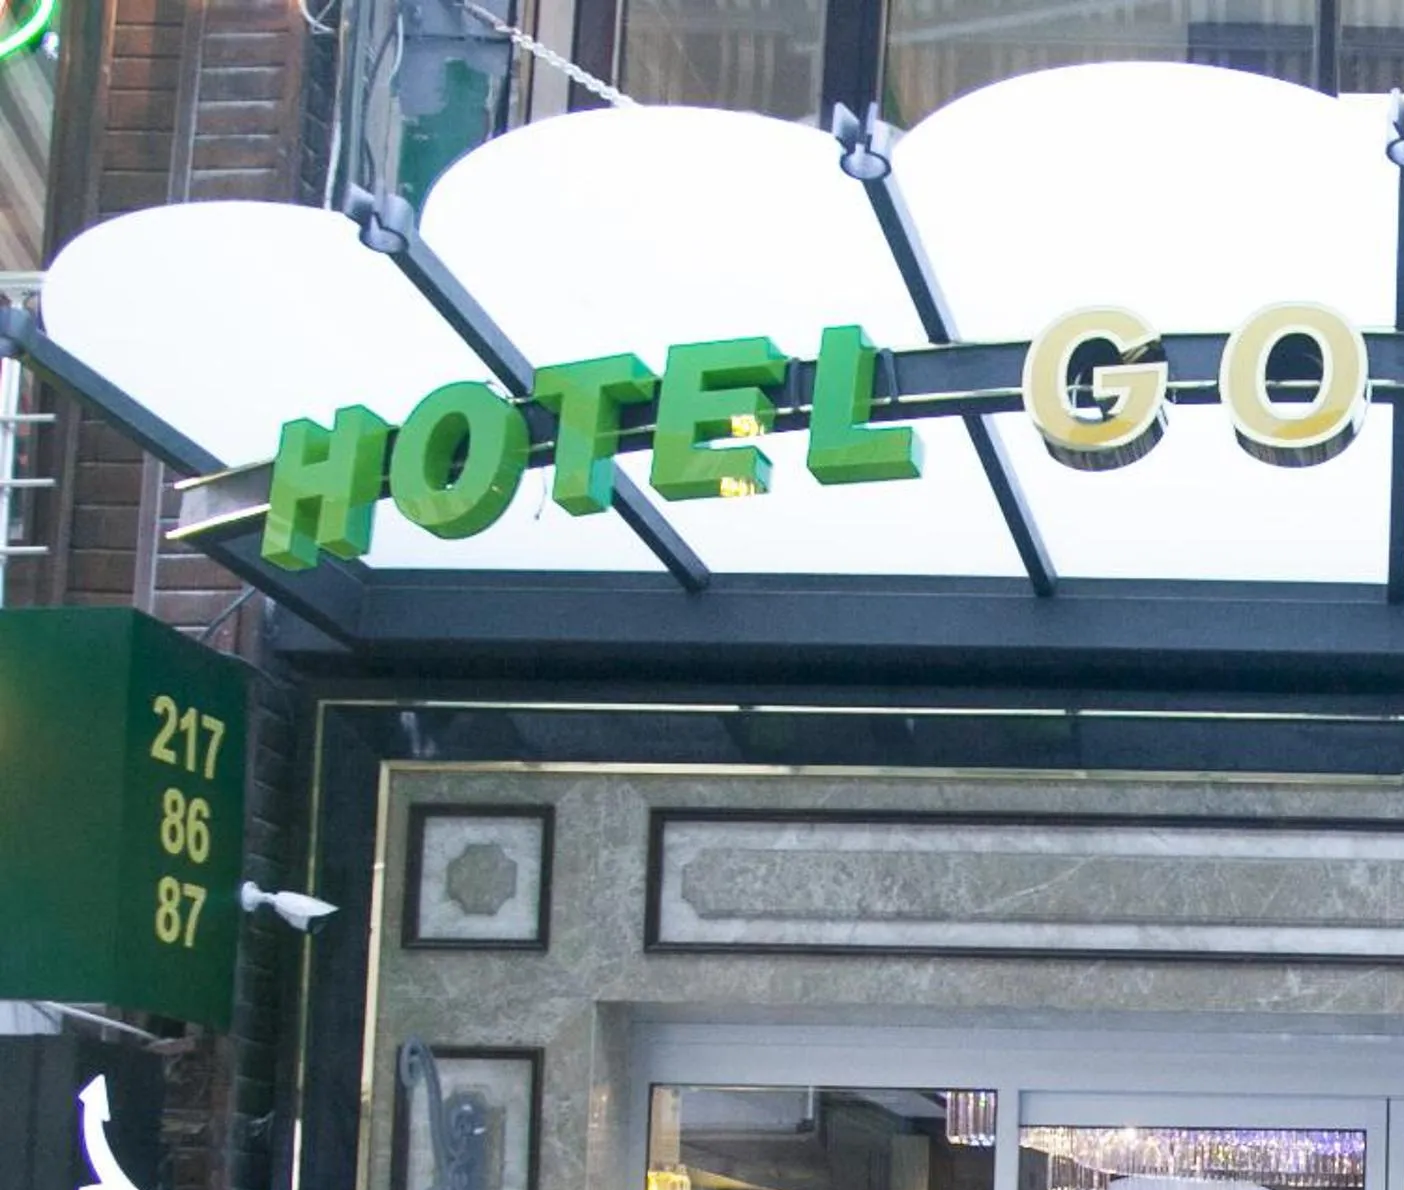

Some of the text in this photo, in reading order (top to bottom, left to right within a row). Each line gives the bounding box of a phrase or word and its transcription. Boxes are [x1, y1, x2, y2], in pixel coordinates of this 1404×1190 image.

[260, 325, 924, 571] HOTEL
[150, 695, 226, 780] 217
[161, 787, 211, 864] 86
[155, 876, 207, 948] 87
